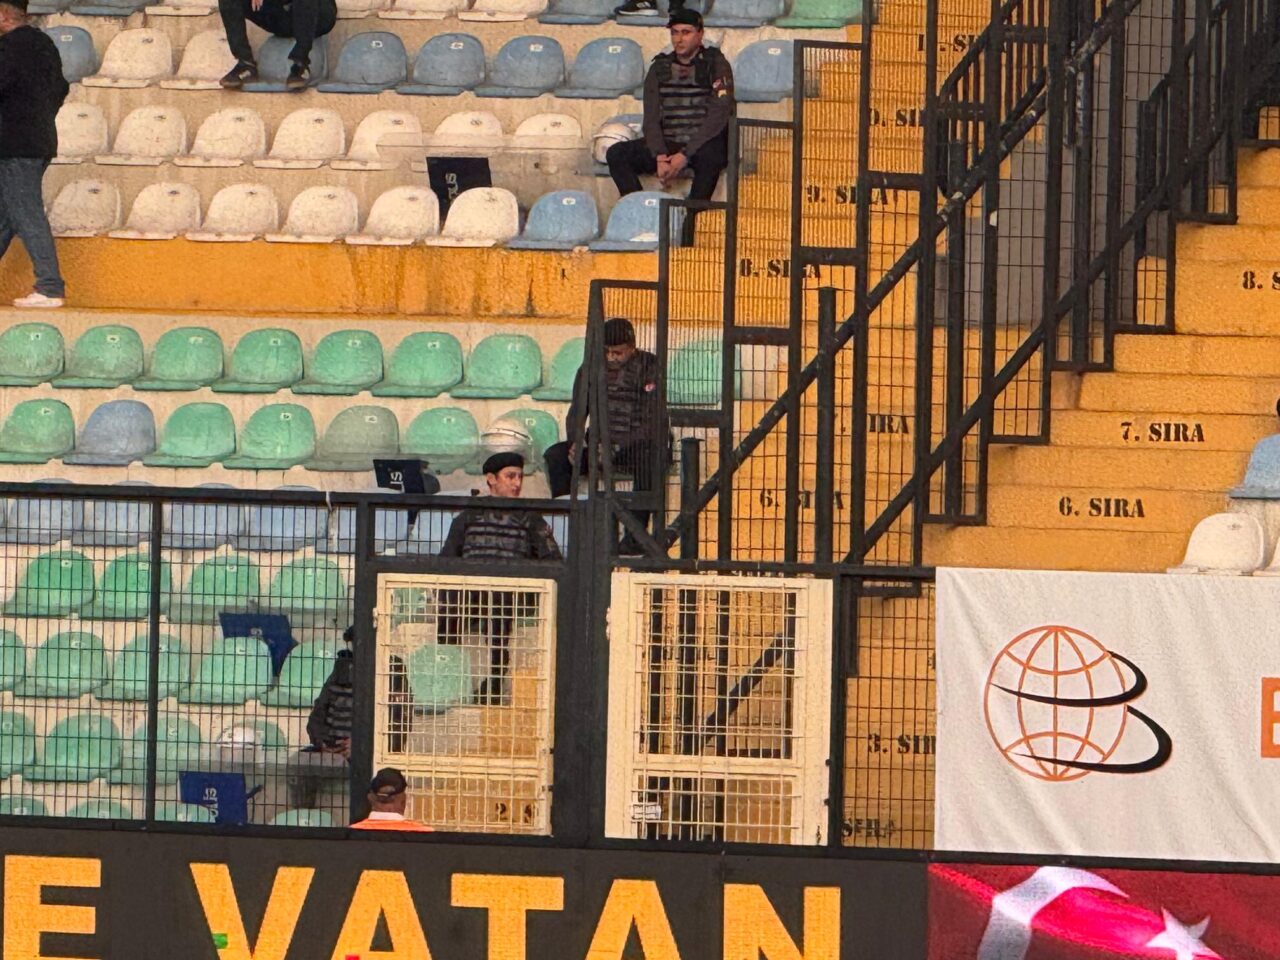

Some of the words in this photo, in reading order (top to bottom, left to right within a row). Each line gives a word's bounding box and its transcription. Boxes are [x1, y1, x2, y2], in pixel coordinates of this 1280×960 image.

[1242, 270, 1264, 290] 8.
[1120, 421, 1140, 442] 7.
[1148, 422, 1205, 443] SIRA
[1058, 496, 1081, 517] 6.
[1088, 497, 1145, 518] SIRA
[189, 862, 842, 960] VATAN
